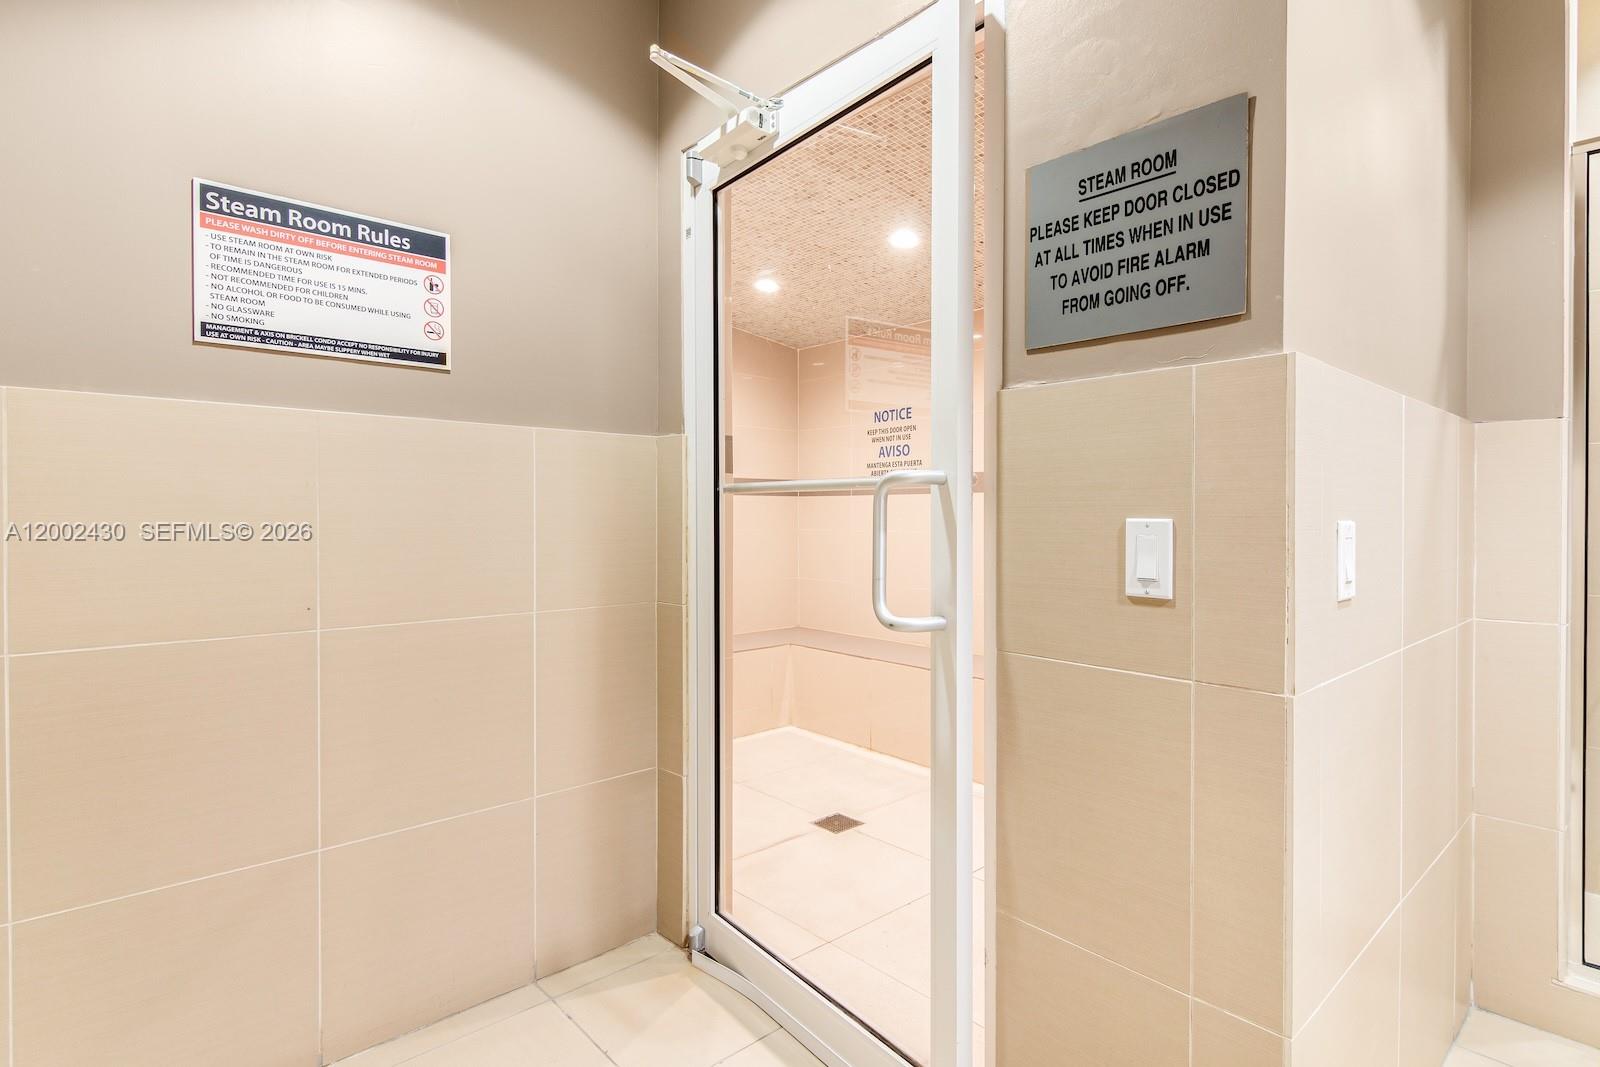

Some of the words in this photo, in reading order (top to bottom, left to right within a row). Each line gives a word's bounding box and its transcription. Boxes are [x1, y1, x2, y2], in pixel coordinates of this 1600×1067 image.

[1078, 166, 1126, 195] STEAM
[1131, 150, 1177, 179] ROOM
[206, 192, 281, 223] Steam
[288, 209, 351, 238] Room
[358, 224, 410, 250] Rules
[1030, 215, 1079, 242] PLEASE
[1084, 204, 1119, 229] KEEP
[1125, 189, 1168, 217] DOOR
[1173, 169, 1240, 202] CLOSED
[206, 217, 240, 230] PLEASE
[242, 224, 268, 236] WASH
[270, 230, 296, 241] DIRTY
[298, 236, 314, 245] OFF
[316, 239, 347, 251] BEFORE
[349, 246, 387, 259] ENTERING
[388, 254, 413, 264] STEAM
[415, 260, 437, 269] ROOM
[210, 233, 226, 241] USE
[229, 237, 256, 247] STEAM
[259, 242, 282, 252] ROOM
[296, 249, 314, 258] OWN
[1035, 251, 1051, 268] AT
[1055, 244, 1079, 263] ALL
[1083, 232, 1124, 256] TIMES
[1130, 218, 1173, 244] WHEN
[1178, 213, 1193, 231] IN
[1199, 202, 1232, 226] USE
[211, 263, 275, 280] RECOMMENDED
[277, 274, 295, 283] TIME
[297, 277, 312, 286] FOR
[314, 280, 327, 288] USE
[348, 286, 367, 295] MINS.
[222, 255, 242, 264] TIME
[254, 260, 302, 274] DANGEROUS
[224, 245, 255, 256] REMAIN
[258, 251, 265, 259] IN
[267, 253, 282, 261] THE
[284, 256, 310, 267] STEAM
[312, 260, 334, 271] ROOM
[336, 266, 350, 274] FOR
[352, 270, 388, 280] EXTENDED
[390, 276, 418, 286] PERIODS
[1051, 273, 1067, 290] TO
[1072, 263, 1113, 286] AVOID
[1118, 254, 1150, 275] FIRE
[1154, 239, 1210, 267] ALARM
[210, 293, 238, 302] STEAM
[240, 297, 266, 306] ROOM
[211, 273, 228, 281] NOT
[231, 276, 294, 292] RECOMMENDED
[296, 287, 310, 295] FOR
[312, 289, 348, 300] CHILDREN
[1062, 293, 1100, 314] FROM
[1104, 282, 1150, 306] GOING
[1156, 275, 1190, 296] OFF.
[226, 286, 264, 297] ALCOHOL
[280, 294, 301, 303] FOOD
[325, 301, 366, 312] CONSUMED
[368, 307, 389, 316] WHILE
[391, 310, 411, 319] USING
[226, 305, 275, 317] GLASSWARE
[226, 315, 265, 325] SMOKING
[206, 324, 253, 335] MANAGEMENT
[260, 330, 274, 338] AXIS
[286, 334, 313, 342] BRICKELL
[315, 337, 336, 345] CONDO
[368, 344, 409, 354] RESPONSIBILITY
[266, 338, 293, 346] CAUTION
[315, 344, 334, 352] MAYBE
[335, 347, 361, 355] SLIPPERY
[874, 407, 912, 423] NOTICE
[879, 444, 910, 458] AVISO
